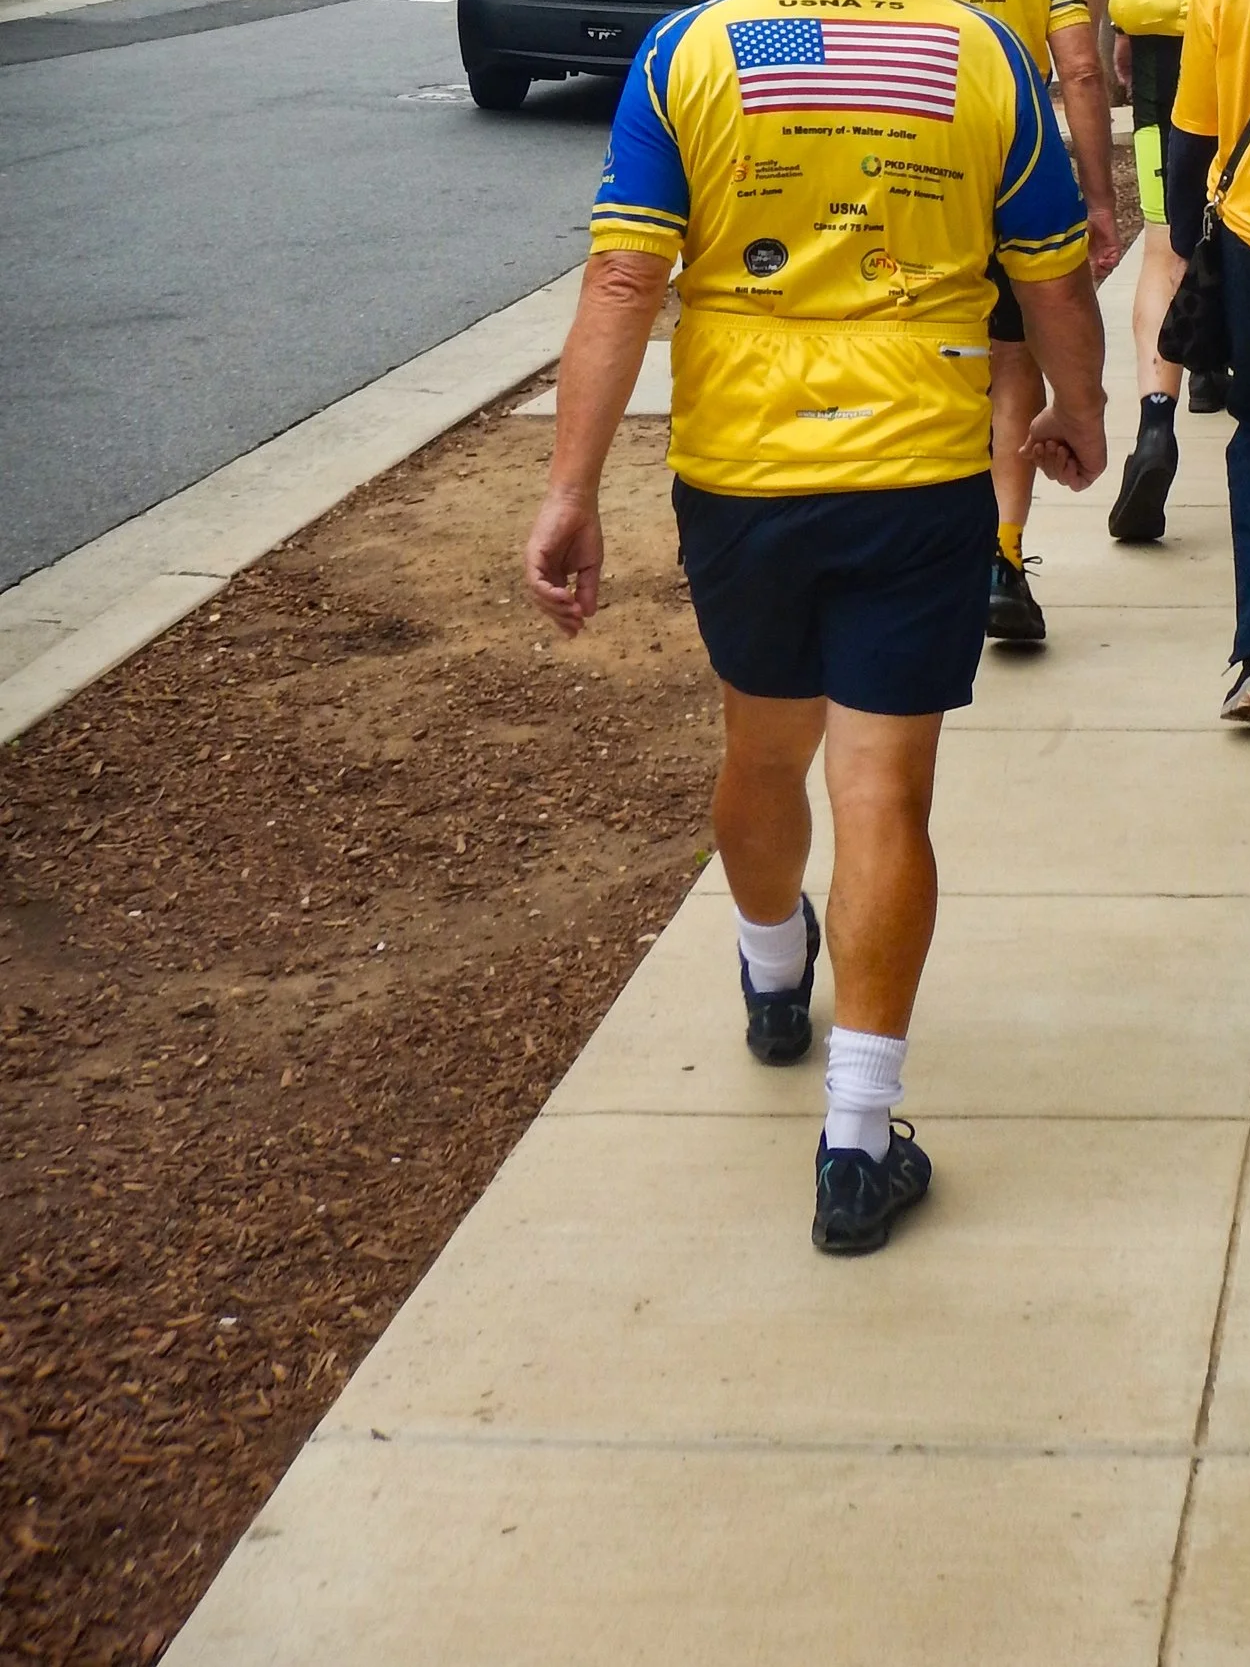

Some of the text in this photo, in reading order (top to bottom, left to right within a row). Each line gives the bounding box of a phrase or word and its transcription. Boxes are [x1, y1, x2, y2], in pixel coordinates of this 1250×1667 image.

[869, 0, 905, 10] 75
[782, 126, 792, 135] In
[794, 126, 833, 137] Memory
[852, 126, 884, 137] Walter
[887, 128, 917, 140] Joller
[884, 160, 905, 170] PKD
[906, 162, 964, 180] FOUNDATION
[755, 171, 803, 180] foundation
[737, 189, 757, 198] Carl
[889, 186, 912, 197] Andy
[829, 202, 868, 215] USNA
[813, 223, 837, 231] Class
[838, 223, 847, 231] of
[849, 223, 861, 232] 75
